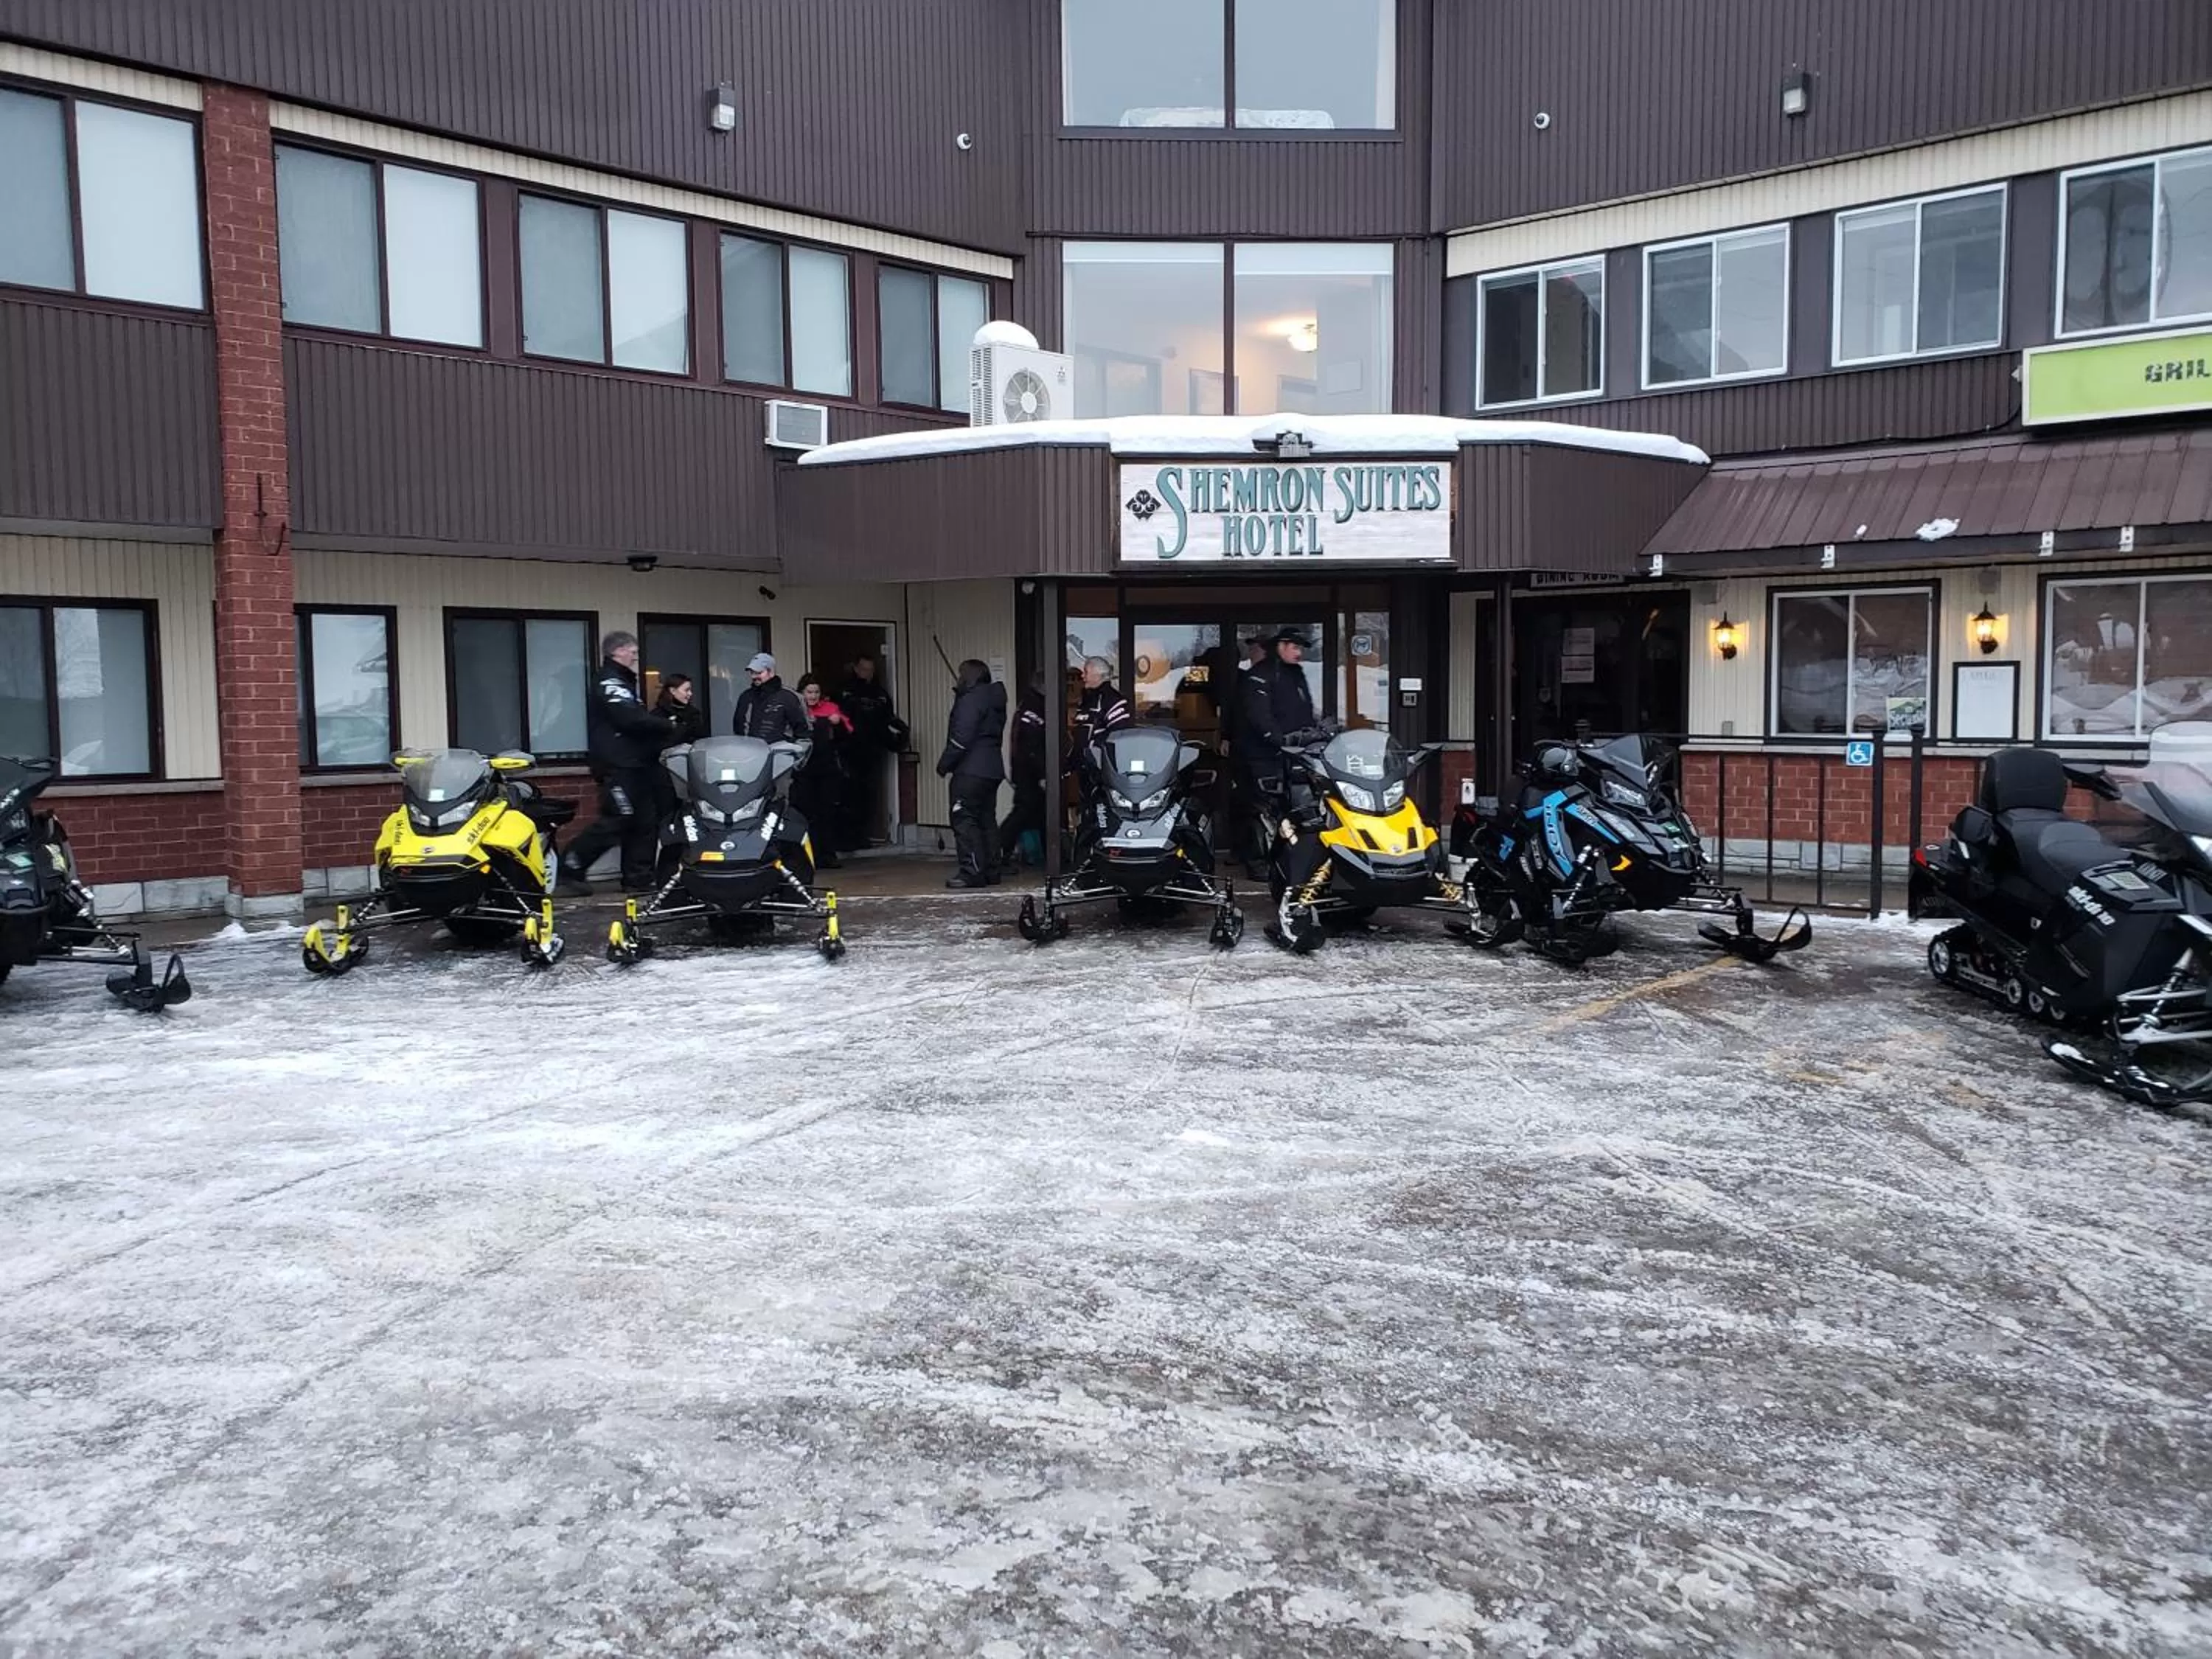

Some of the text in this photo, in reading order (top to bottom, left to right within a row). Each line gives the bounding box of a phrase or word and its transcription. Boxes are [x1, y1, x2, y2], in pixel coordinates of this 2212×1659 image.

[1155, 465, 1442, 559] SHEMRON SUITES
[1222, 515, 1325, 557] HOTEL
